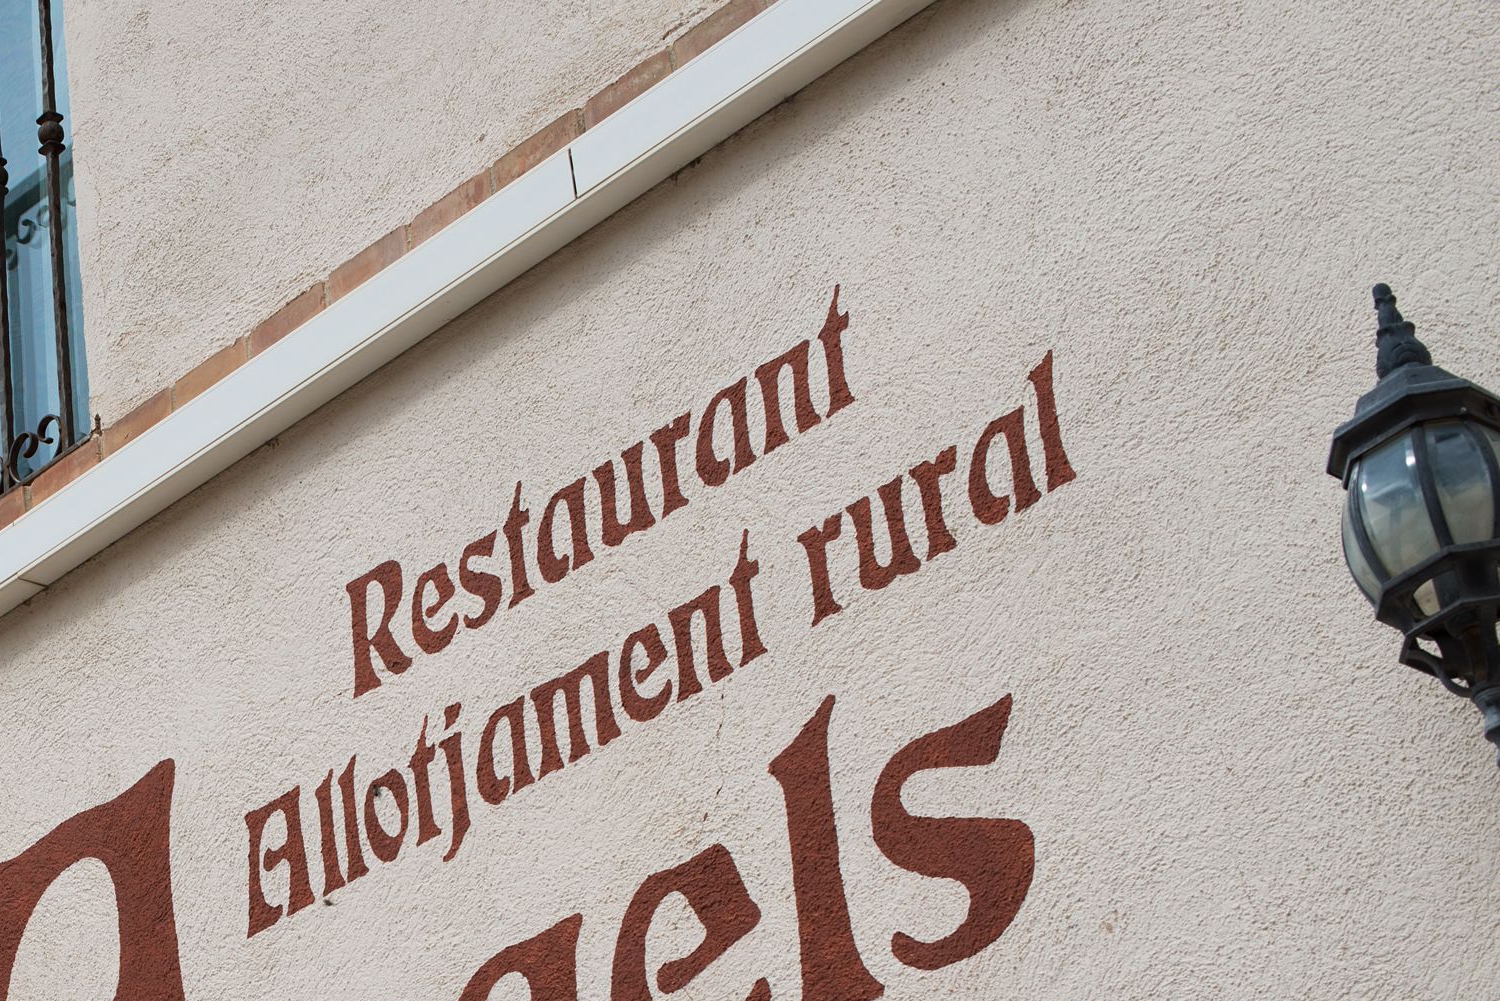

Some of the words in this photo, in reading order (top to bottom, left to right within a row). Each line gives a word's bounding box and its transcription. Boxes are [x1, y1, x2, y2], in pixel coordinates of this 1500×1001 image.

[244, 528, 769, 939] Allotjament
[797, 349, 1078, 630] rural
[345, 283, 856, 699] Restaurant
